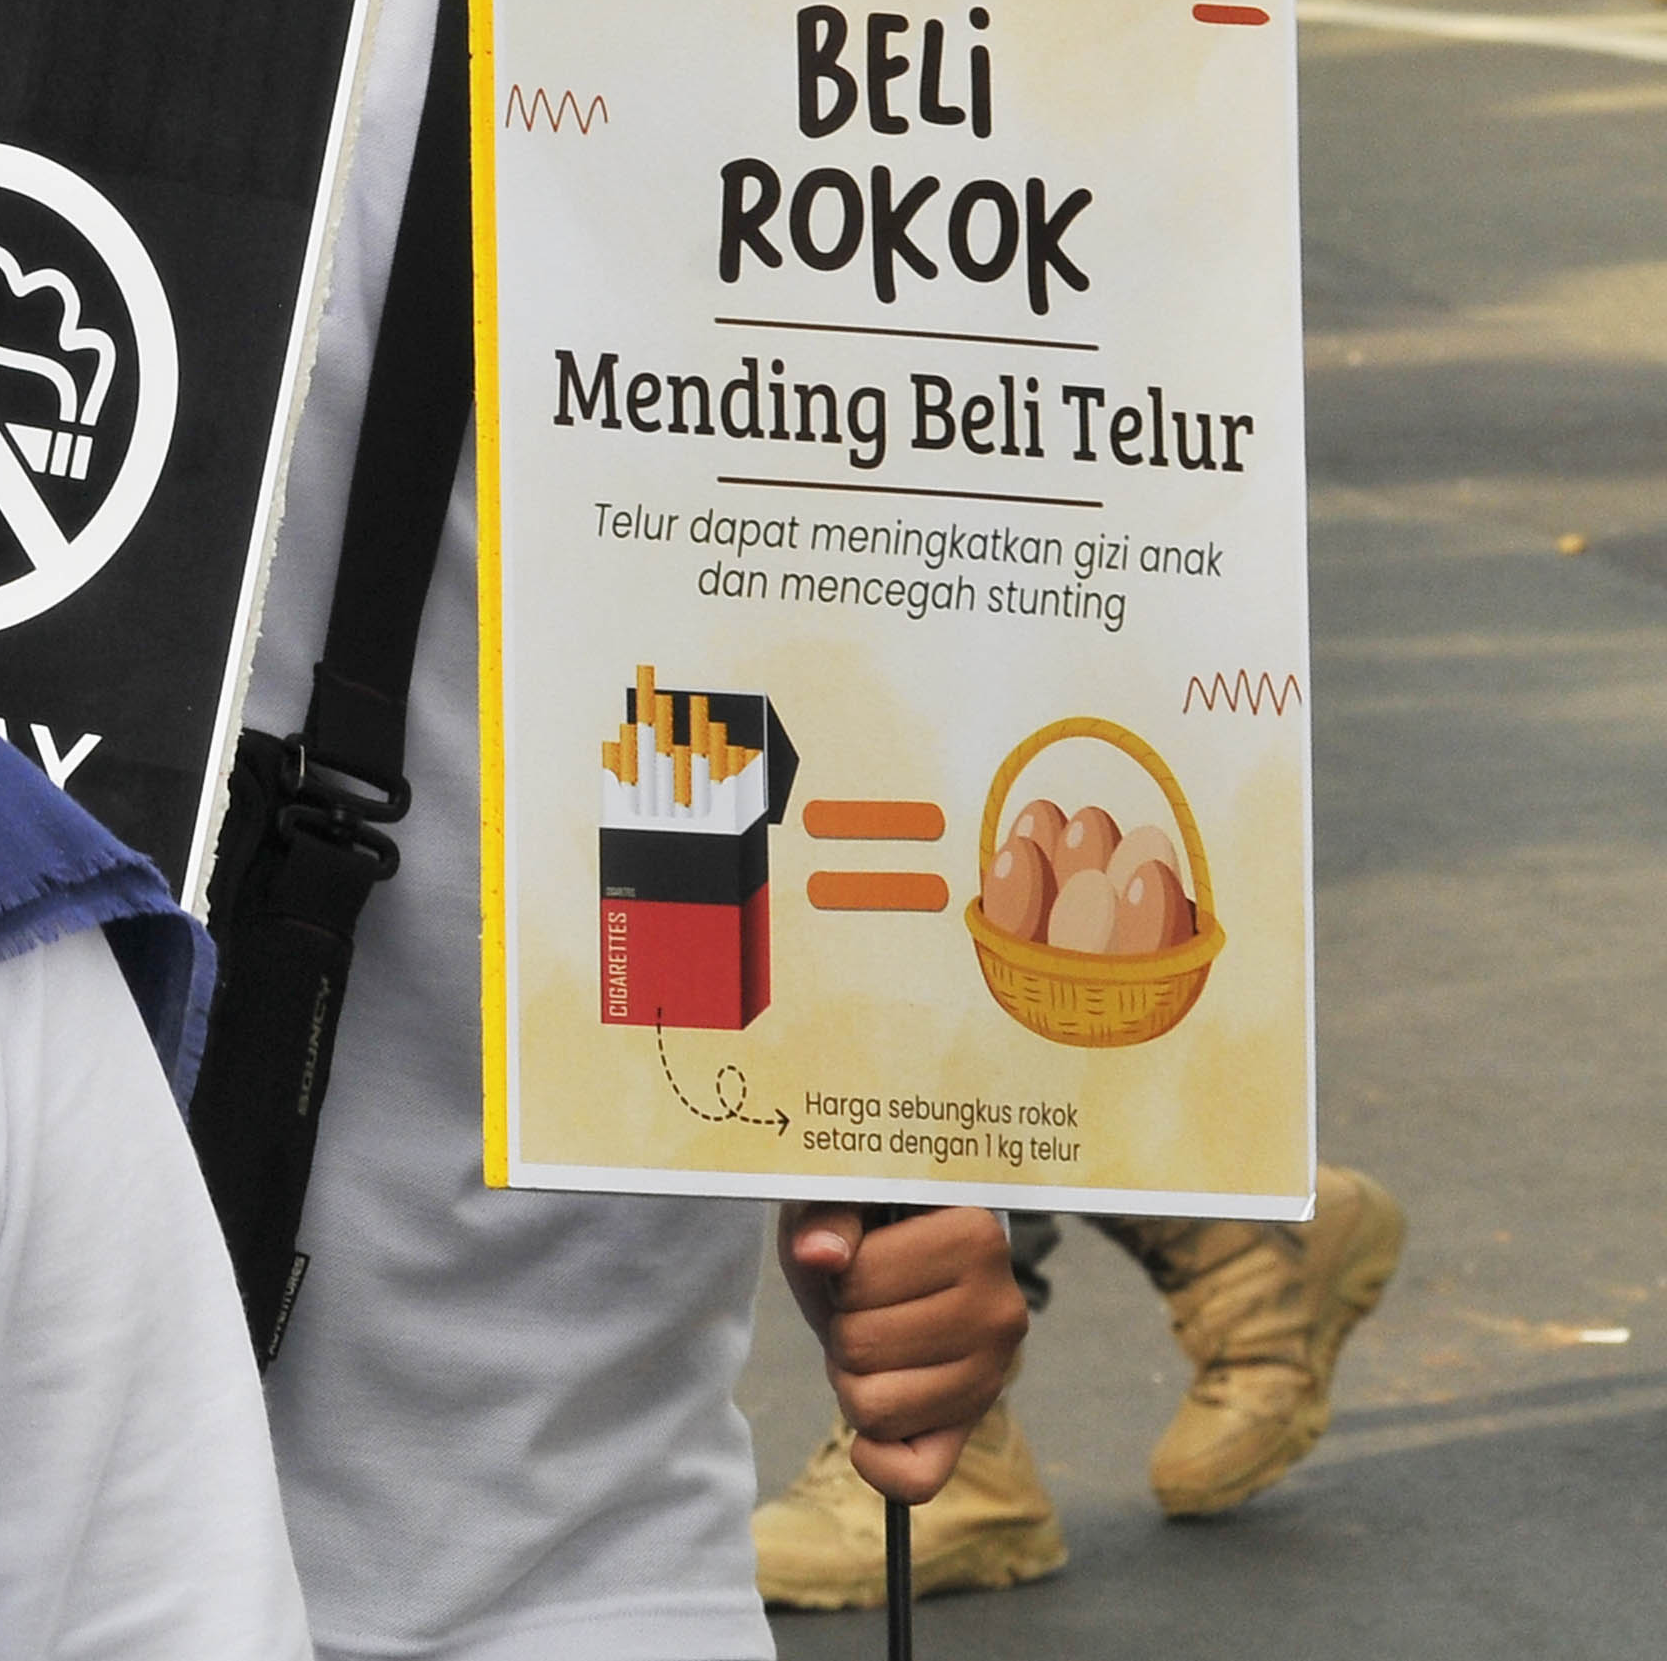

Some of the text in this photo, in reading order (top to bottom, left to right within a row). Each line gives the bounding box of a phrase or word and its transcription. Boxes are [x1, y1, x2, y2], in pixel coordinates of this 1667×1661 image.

[718, 157, 1094, 316] ROKOK
[552, 348, 1256, 474] Mending Beli Telur
[593, 501, 1225, 580] Telur dapat meningkatkan gizi anak
[697, 560, 1129, 633] dan mencegah stunting
[607, 911, 630, 1020] CIGARETTES
[802, 1126, 883, 1153] setara
[888, 1128, 979, 1164] dengan
[997, 1132, 1024, 1168] kg
[1029, 1136, 1082, 1162] telur
[804, 1091, 1080, 1130] Harga sebungkus rokok
